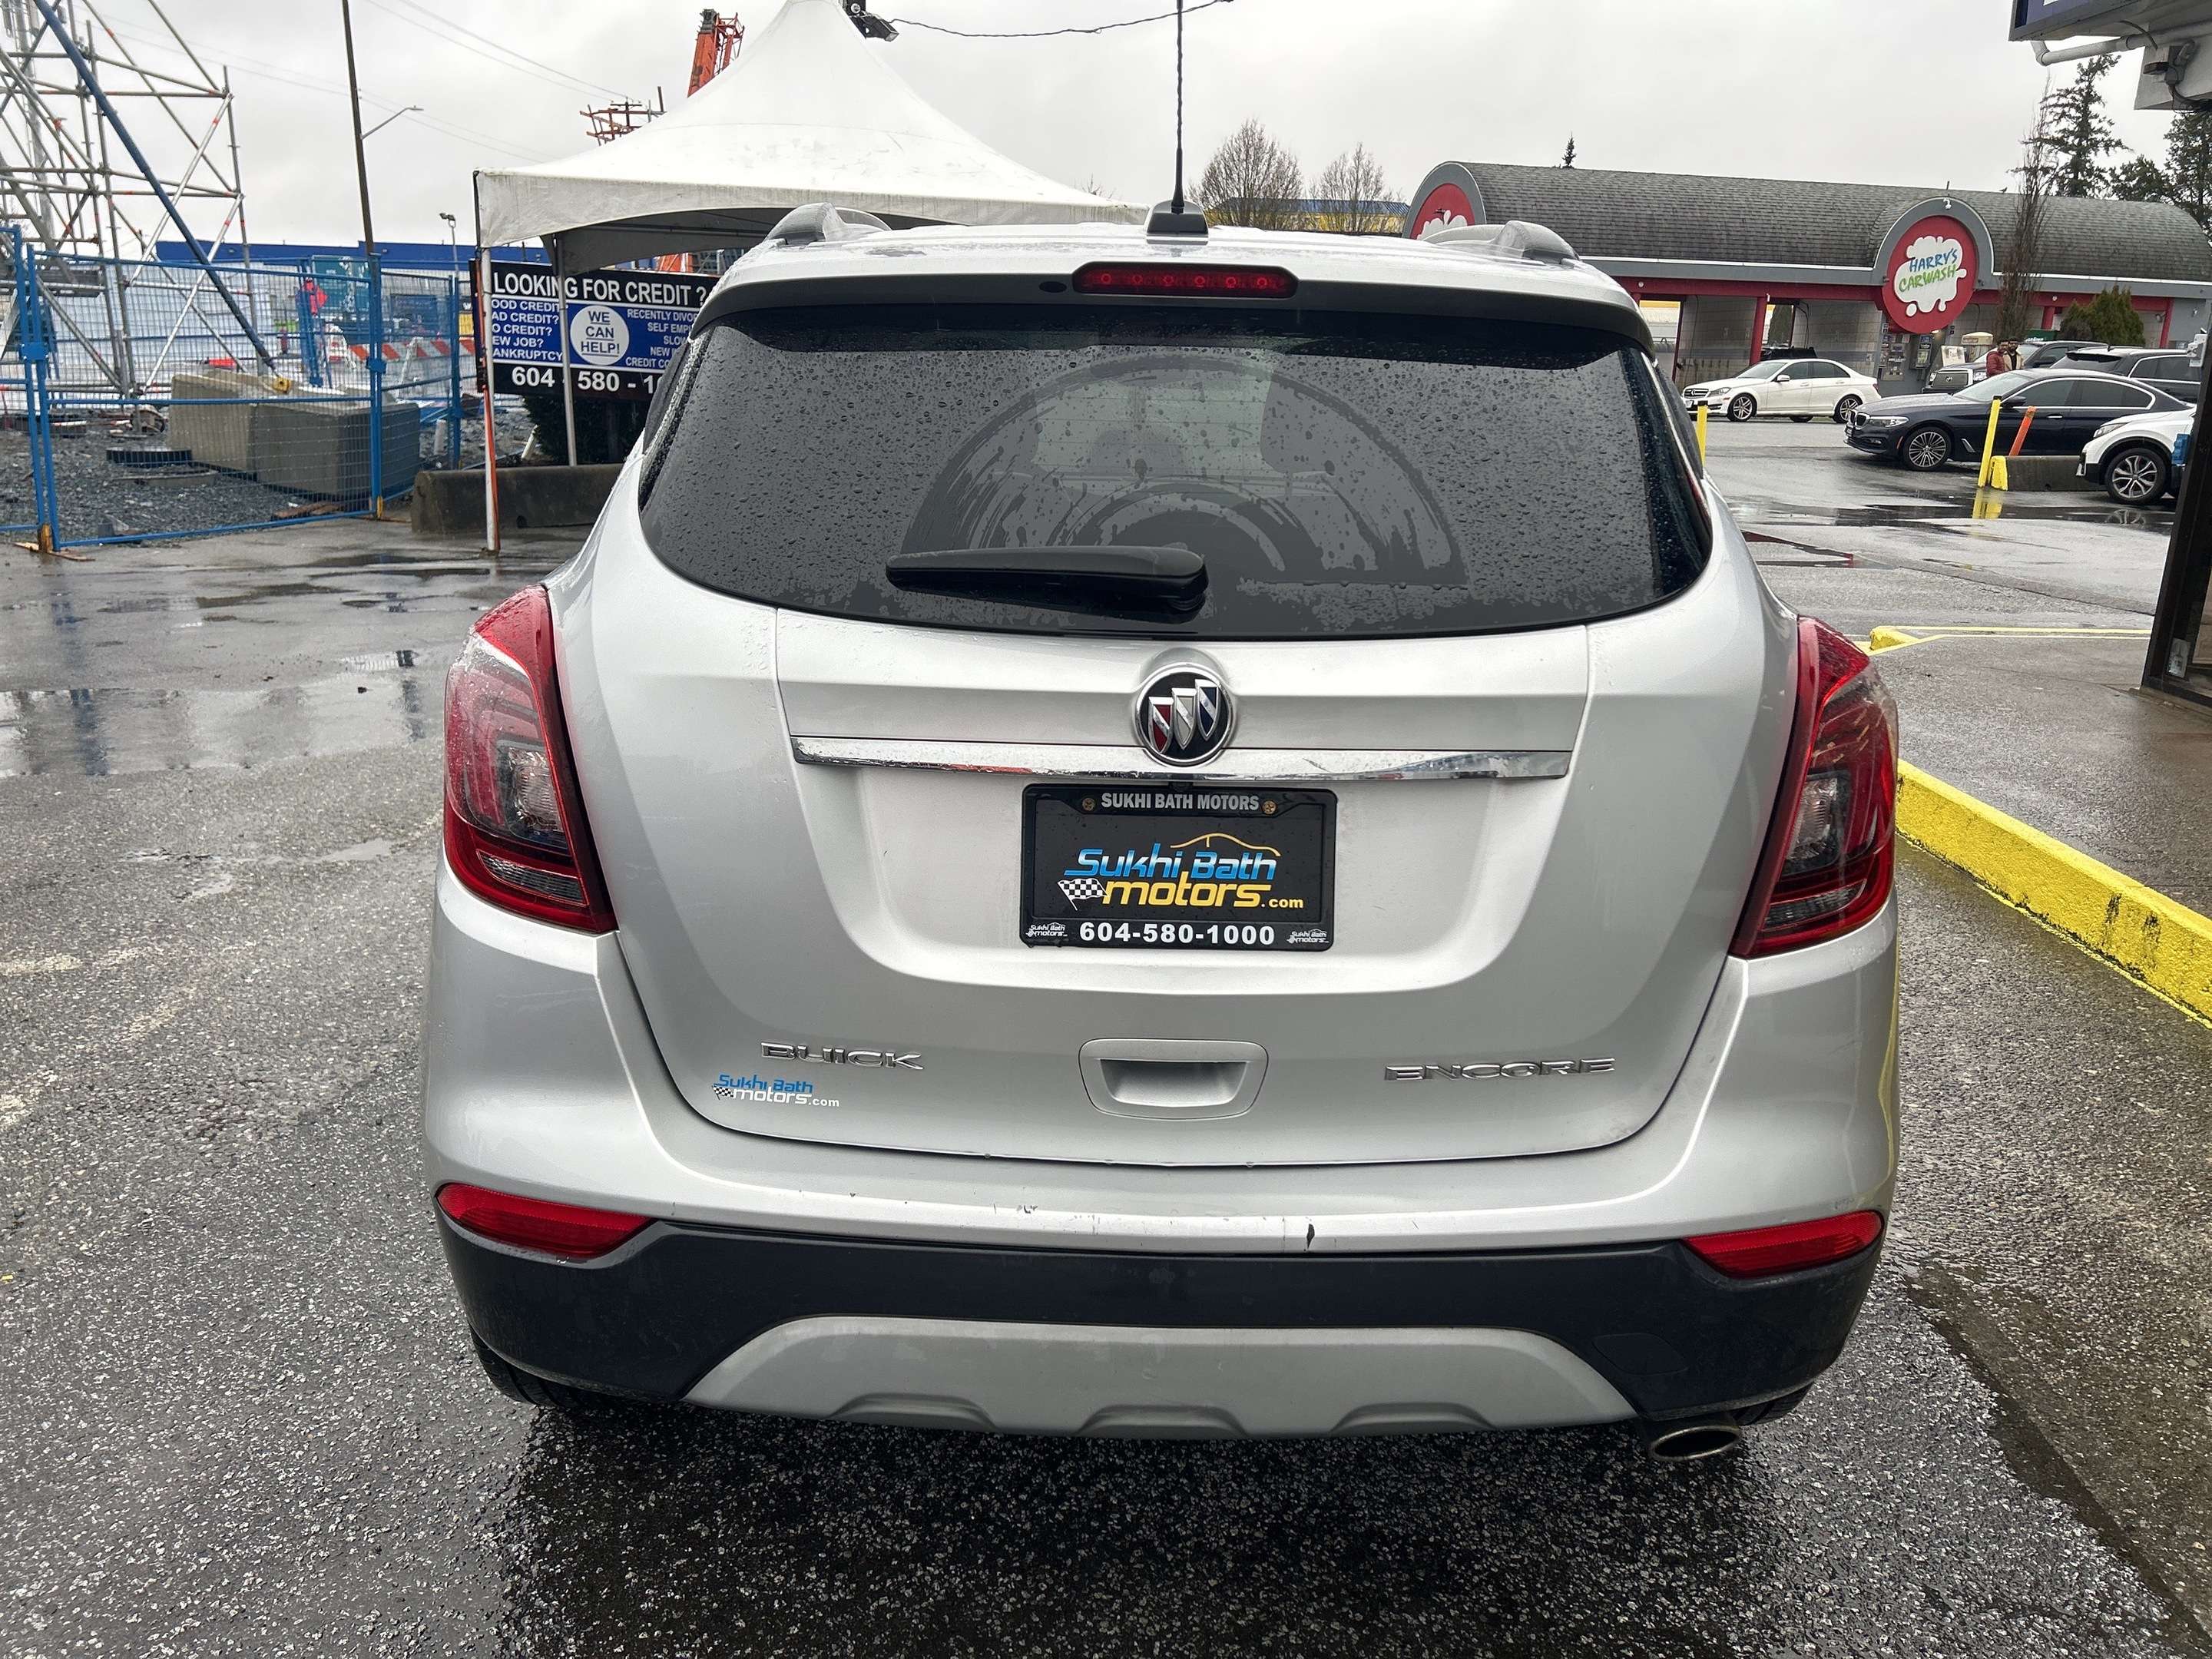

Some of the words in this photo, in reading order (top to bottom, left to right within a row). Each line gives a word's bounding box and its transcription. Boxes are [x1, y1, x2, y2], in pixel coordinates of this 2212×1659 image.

[1909, 248, 1958, 272] HARRY'S
[1899, 264, 1957, 292] CARWASH
[493, 272, 578, 298] LOOKING
[582, 279, 622, 301] FOR
[625, 281, 691, 306] CREDIT
[492, 299, 517, 310] OOD
[520, 301, 568, 313] CREDIT
[492, 311, 508, 322] AD
[510, 313, 559, 325] CREDIT?
[588, 311, 610, 323] WE
[627, 309, 671, 321] RECENTLY
[492, 324, 501, 333] O
[503, 325, 553, 336] CREDIT?
[586, 326, 614, 339] CAN
[647, 323, 669, 333] SELF
[492, 336, 511, 346] EW
[513, 338, 544, 348] JOB?
[581, 341, 620, 355] HELP!
[492, 348, 563, 361] ANKRUPTCY
[650, 346, 671, 356] NEW
[625, 357, 656, 368] CREDIT
[512, 366, 555, 387] 604
[578, 370, 620, 392] 580
[1101, 793, 1151, 810] SUKHI
[1155, 794, 1193, 810] BATH
[1197, 794, 1260, 810] MOTORS
[1064, 843, 1183, 878] Sukhi
[1192, 851, 1277, 879] Bath
[1079, 922, 1275, 945] 604-580-1000
[760, 1041, 924, 1070] BUICK
[1384, 1058, 1616, 1081] ENCORE
[714, 1074, 769, 1090] Sukhi
[773, 1078, 813, 1094] Bath
